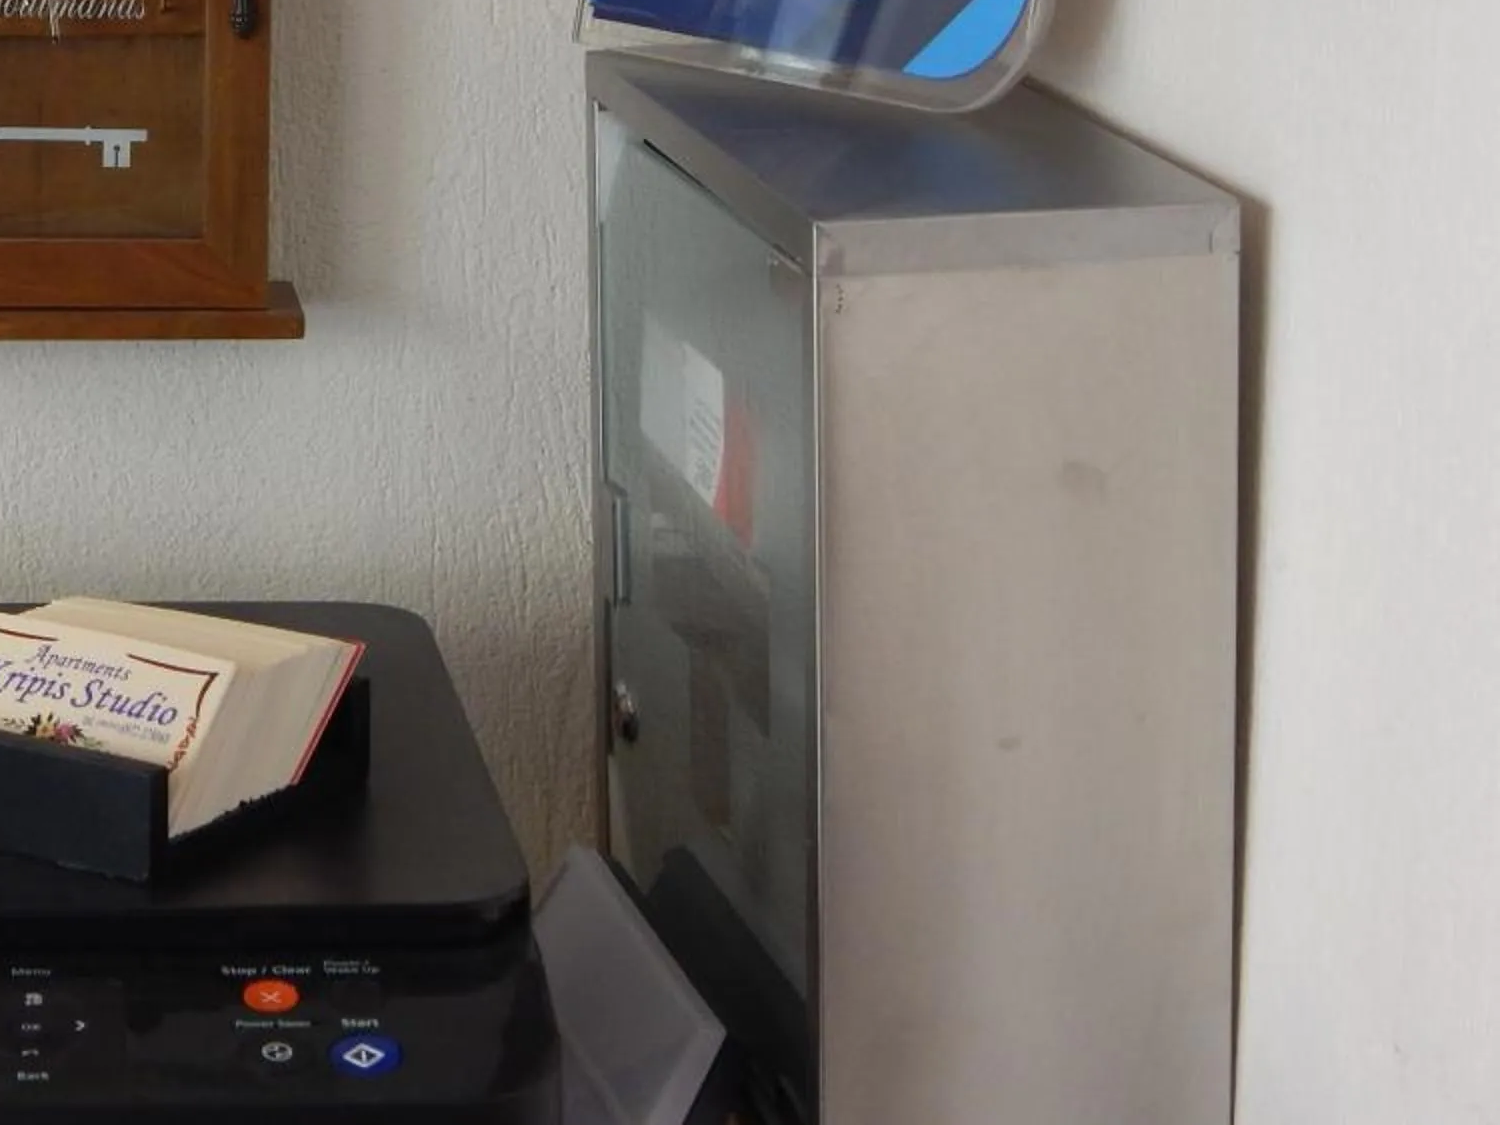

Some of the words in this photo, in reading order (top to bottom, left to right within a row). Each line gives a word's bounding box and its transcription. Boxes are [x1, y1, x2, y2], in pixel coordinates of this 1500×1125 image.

[25, 644, 133, 682] Apartments
[71, 678, 179, 726] Studio
[221, 965, 257, 976] Stop
[272, 965, 312, 975] Clear
[341, 1017, 379, 1029] Start
